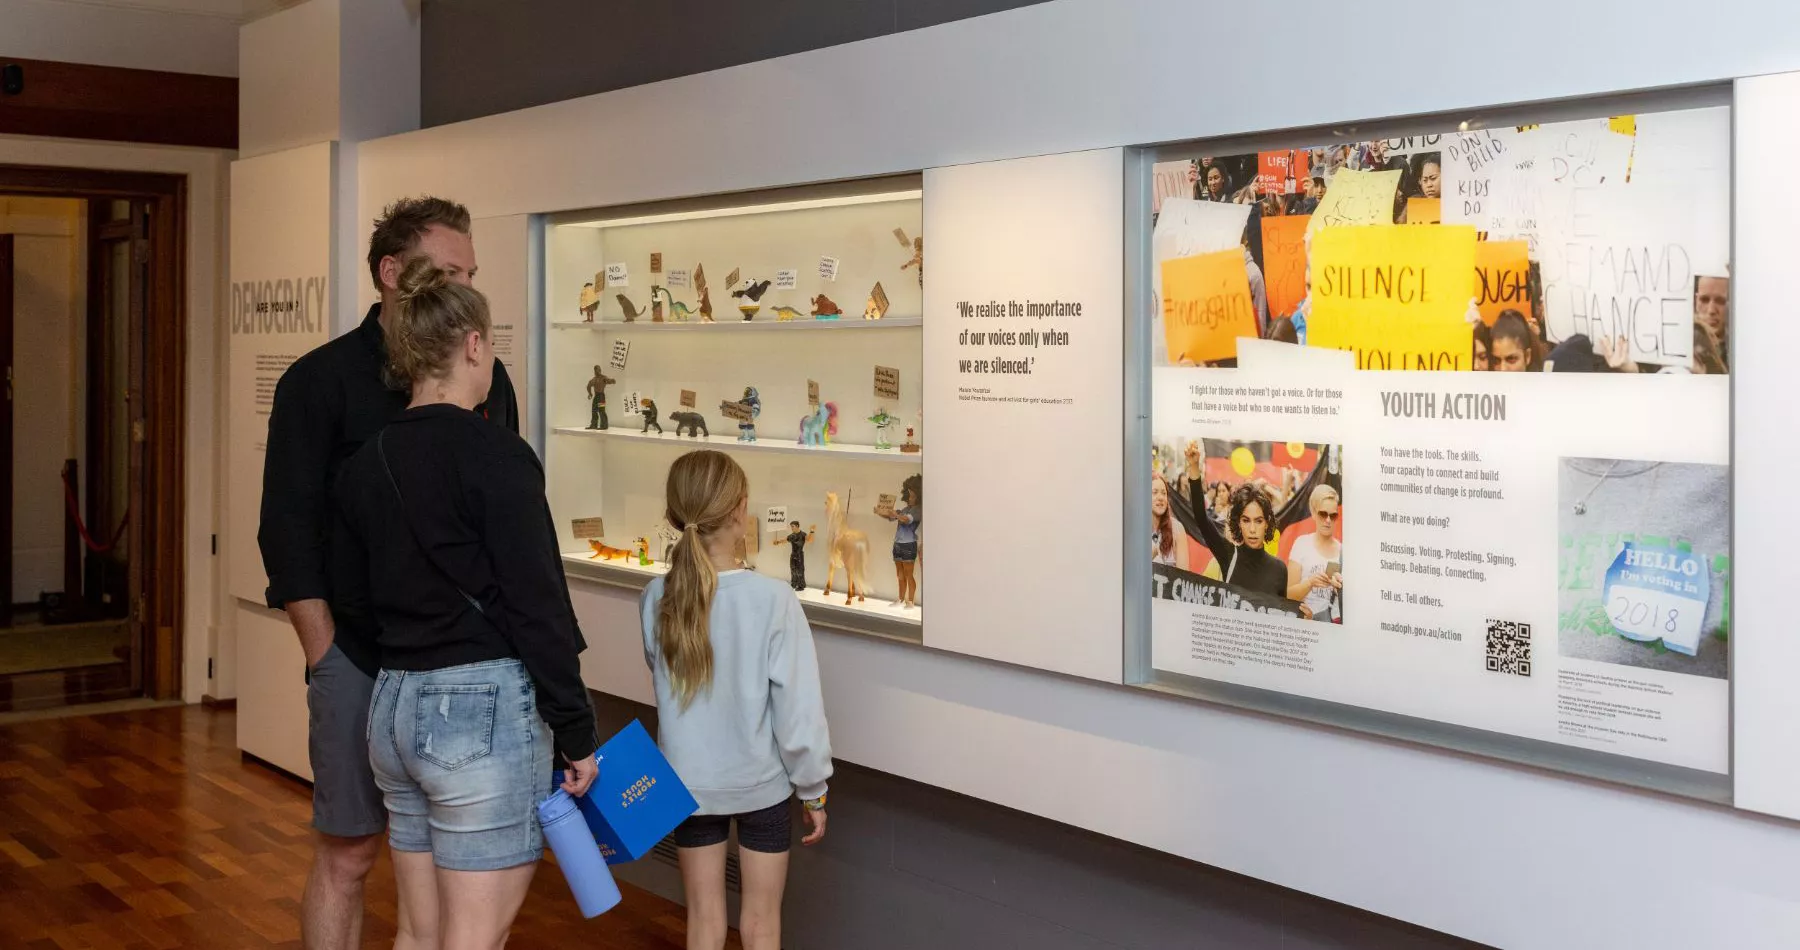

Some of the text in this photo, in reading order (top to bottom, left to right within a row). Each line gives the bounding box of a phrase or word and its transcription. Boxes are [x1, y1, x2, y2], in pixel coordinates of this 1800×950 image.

[1459, 180, 1490, 197] KIDS
[1464, 201, 1481, 215] DO
[1541, 243, 1691, 294] DEMAND
[1319, 264, 1432, 304] SILENCE
[231, 276, 326, 335] DEMOCRACY
[256, 302, 268, 313] ARE
[271, 301, 284, 312] YOU
[286, 301, 293, 312] IN
[976, 301, 1005, 317] realise
[1009, 300, 1023, 317] the
[1027, 300, 1081, 320] importance
[1545, 284, 1687, 358] CHANGE
[959, 328, 1068, 348] of our voices only when
[959, 360, 971, 373] we
[975, 360, 988, 373] are
[1195, 386, 1208, 397] fight
[1209, 386, 1217, 395] for
[1218, 386, 1234, 395] those
[1235, 387, 1247, 396] who
[1272, 388, 1281, 398] got
[1288, 388, 1305, 397] voice.
[1307, 388, 1314, 398] Or
[1315, 388, 1324, 398] for
[1326, 388, 1342, 399] those
[1192, 402, 1202, 410] that
[1204, 402, 1216, 411] have
[1223, 402, 1237, 411] voice
[1239, 403, 1248, 412] but
[1250, 403, 1261, 412] who
[1272, 405, 1283, 413] one
[1285, 405, 1302, 414] wants
[1304, 405, 1310, 414] to
[1312, 405, 1328, 415] listen
[1381, 392, 1506, 420] YOUTH ACTION
[1381, 446, 1481, 462] You have the tools. The skills.
[1381, 464, 1499, 481] Your capacity to connect and build
[1381, 482, 1504, 500] communities of change is profound.
[1381, 511, 1450, 528] What are you doing?
[1381, 542, 1516, 567] Discussing. Voting. Protesting. Signing.
[1624, 549, 1698, 576] HELLO
[1381, 560, 1486, 582] Sharing. Debating. Connecting.
[1172, 577, 1216, 606] CHANGE
[1642, 574, 1682, 591] voting
[1684, 581, 1698, 593] in
[1381, 590, 1444, 607] Tell us. Tell others.
[1615, 596, 1679, 632] 2018
[1381, 622, 1461, 641] moadoph.gov.au/action
[622, 775, 648, 799] HOUSE
[622, 777, 656, 808] PEOPLE'S
